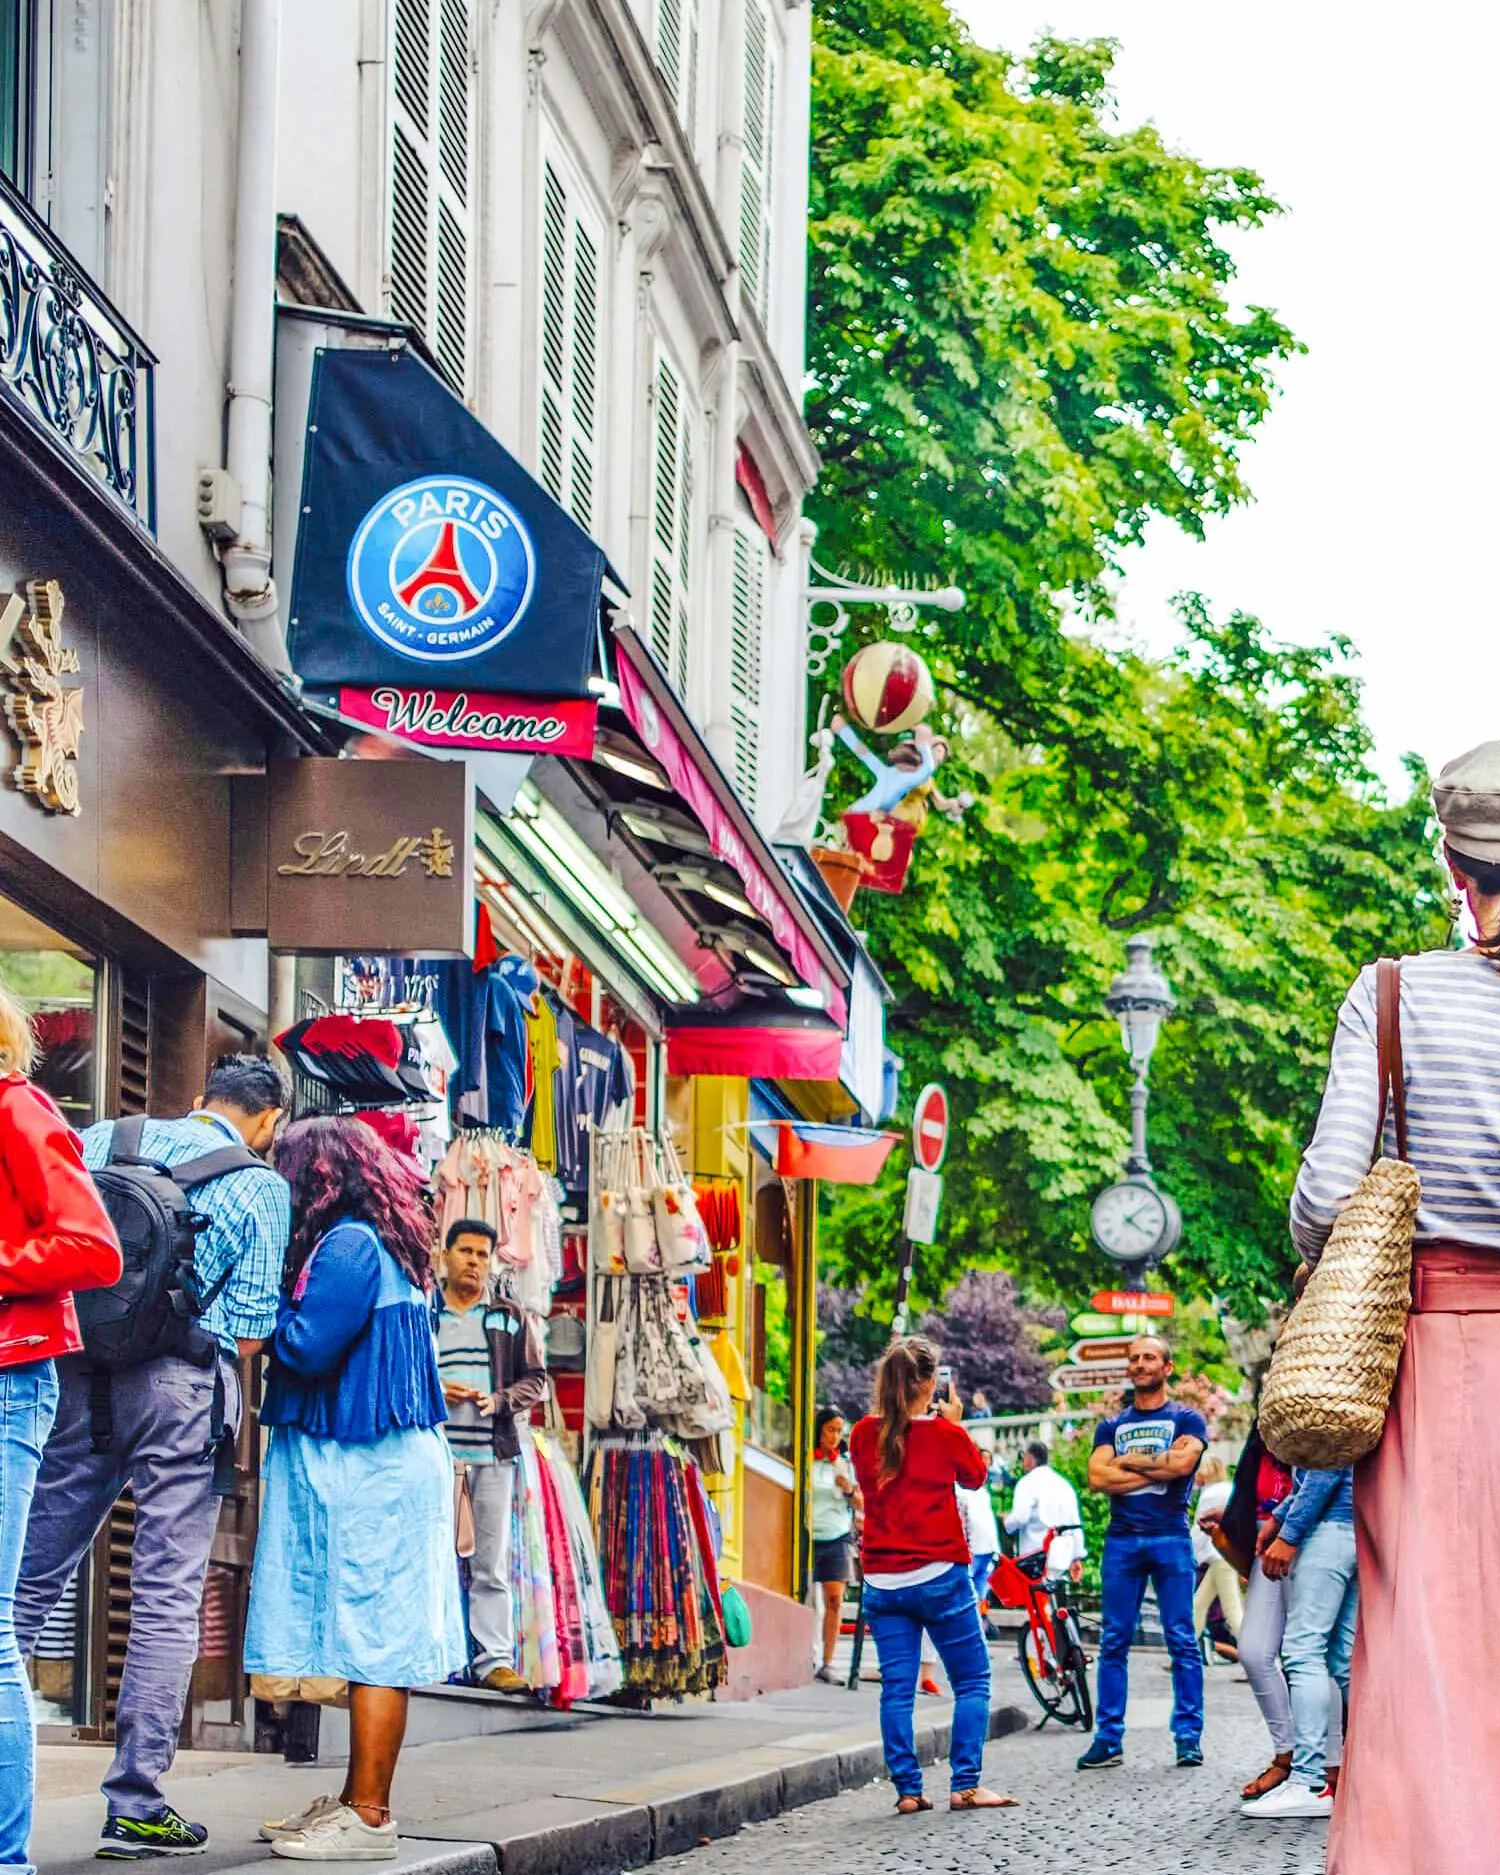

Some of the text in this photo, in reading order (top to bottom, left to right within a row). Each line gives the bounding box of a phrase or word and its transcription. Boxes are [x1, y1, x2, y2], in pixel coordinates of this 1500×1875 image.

[391, 490, 509, 540] PARIS
[377, 602, 495, 645] SAINT GERMAIN
[372, 687, 566, 742] Welcome
[277, 831, 423, 877] Lindt
